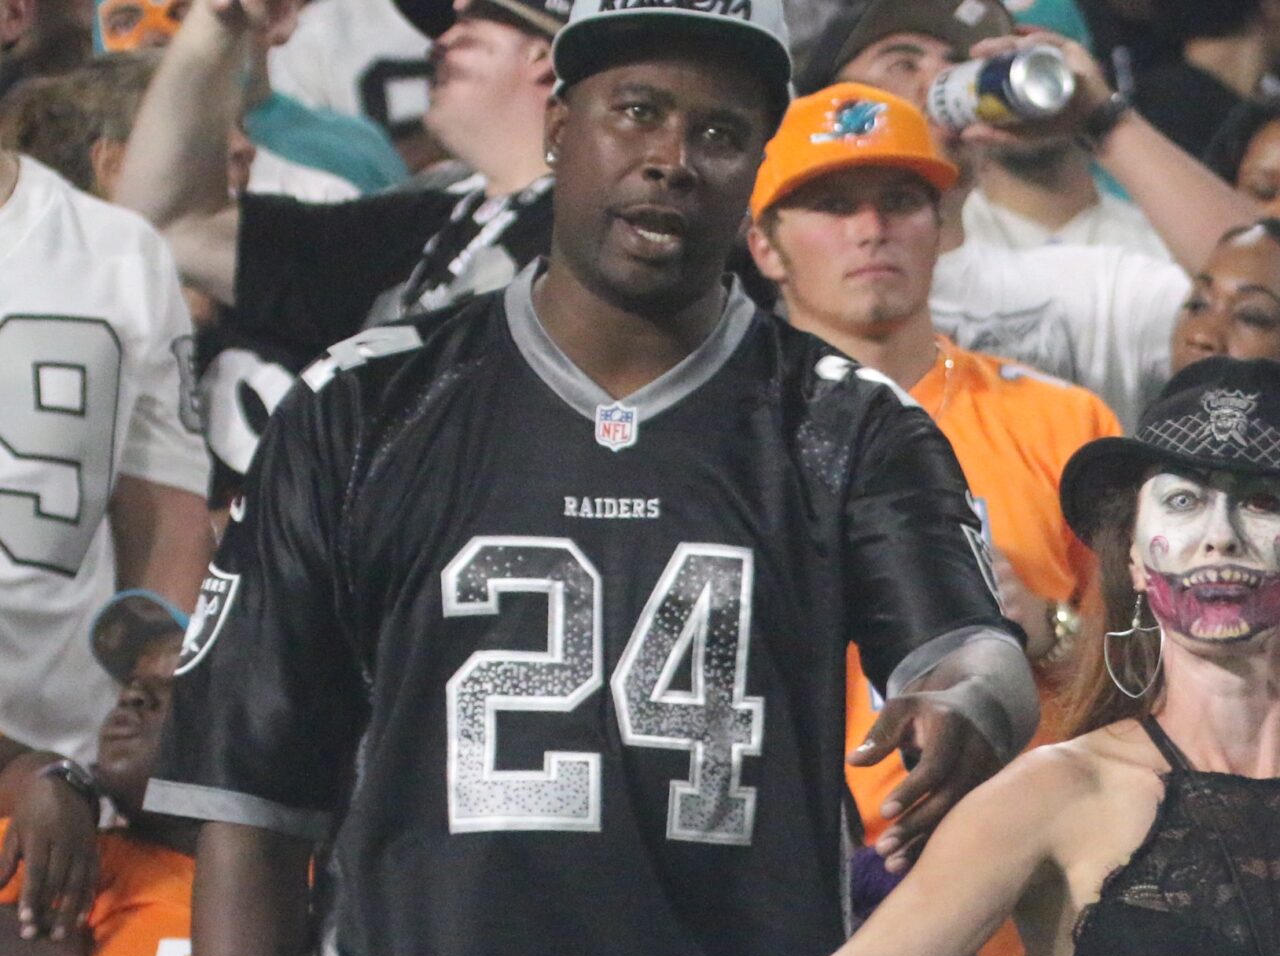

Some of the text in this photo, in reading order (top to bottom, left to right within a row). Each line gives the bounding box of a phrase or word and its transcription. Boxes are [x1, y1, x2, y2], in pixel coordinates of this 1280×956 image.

[601, 423, 629, 441] NFL
[563, 496, 660, 519] RAIDERS
[440, 535, 765, 846] 24
